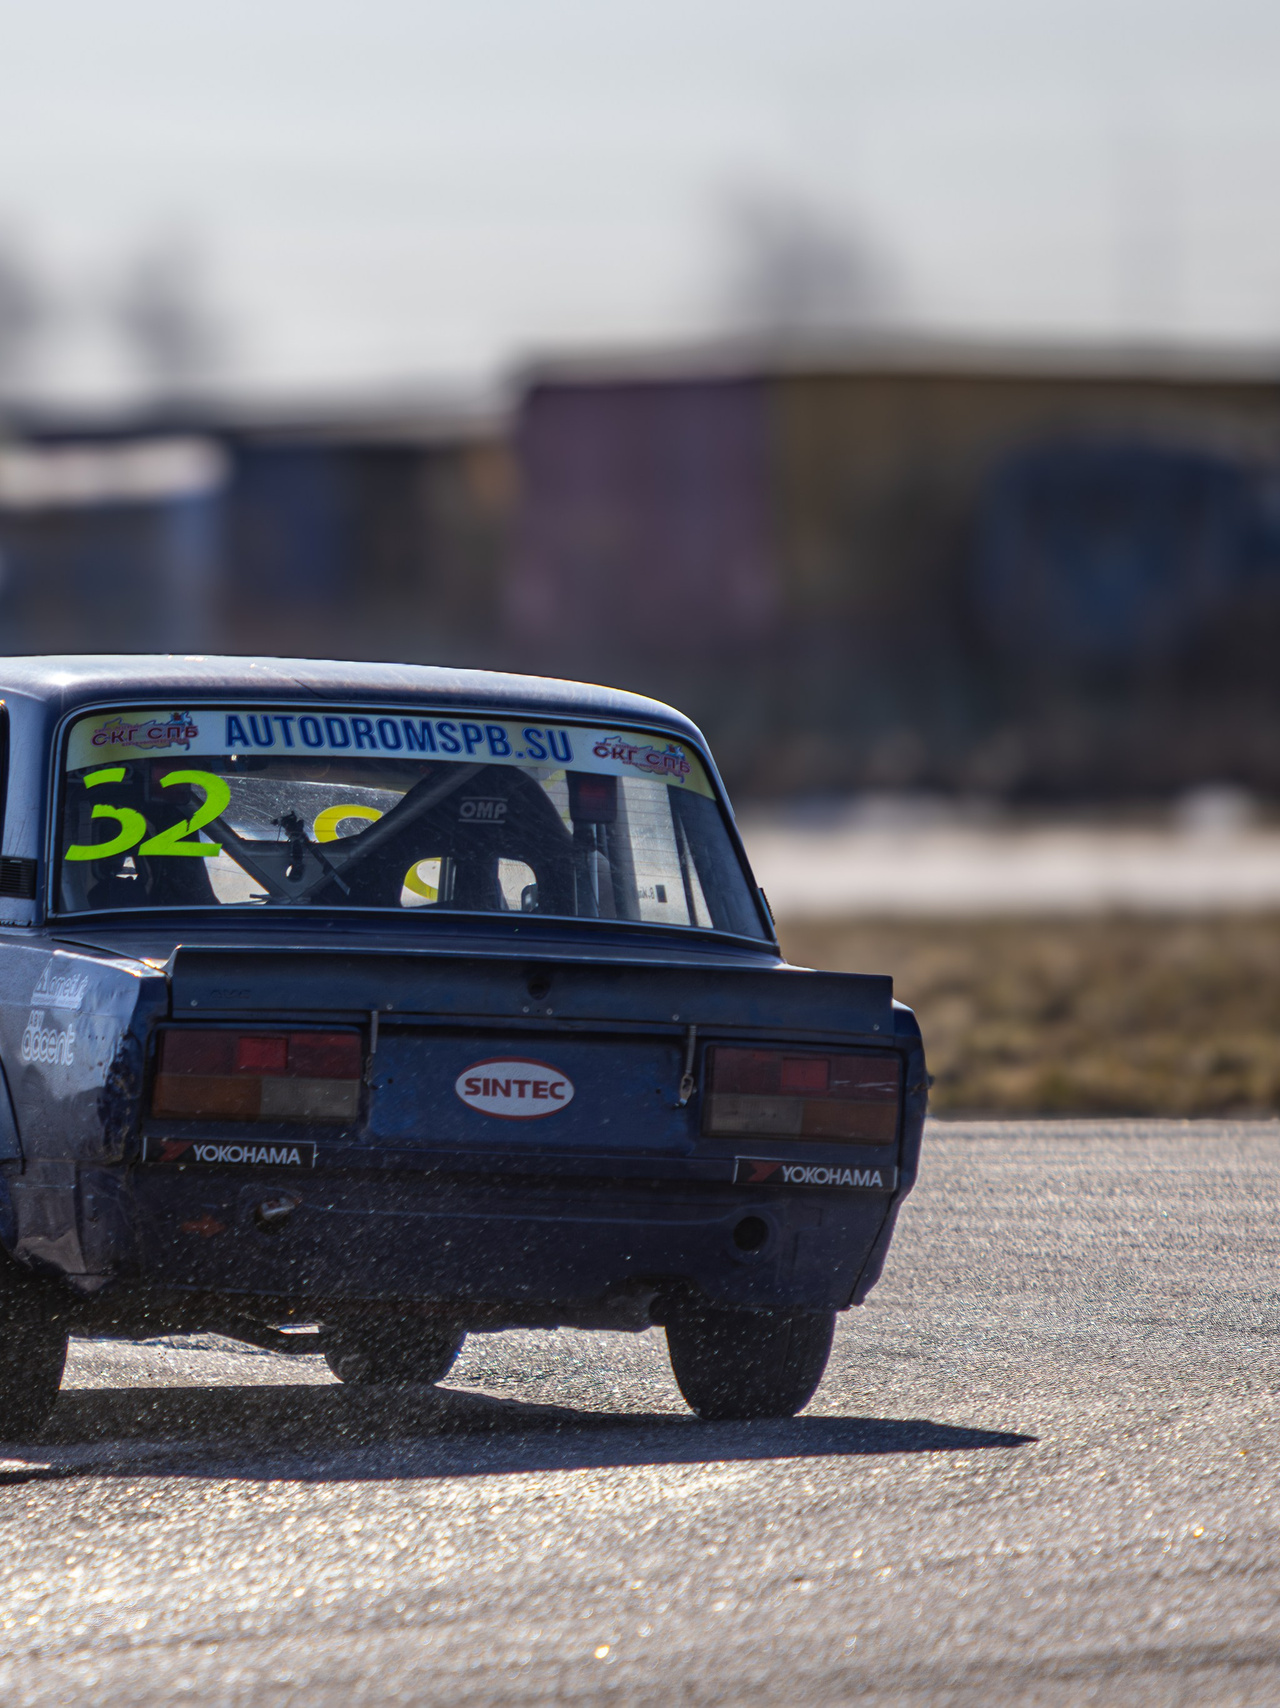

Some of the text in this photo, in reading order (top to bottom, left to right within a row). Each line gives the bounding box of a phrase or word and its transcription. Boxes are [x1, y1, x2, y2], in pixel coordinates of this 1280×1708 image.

[224, 713, 575, 763] AUTODROMSPB.SU
[459, 800, 508, 819] OMP
[464, 1077, 565, 1100] SINTEC
[193, 1144, 301, 1165] YOKOHAMA
[782, 1165, 883, 1187] YOKOHAMA
